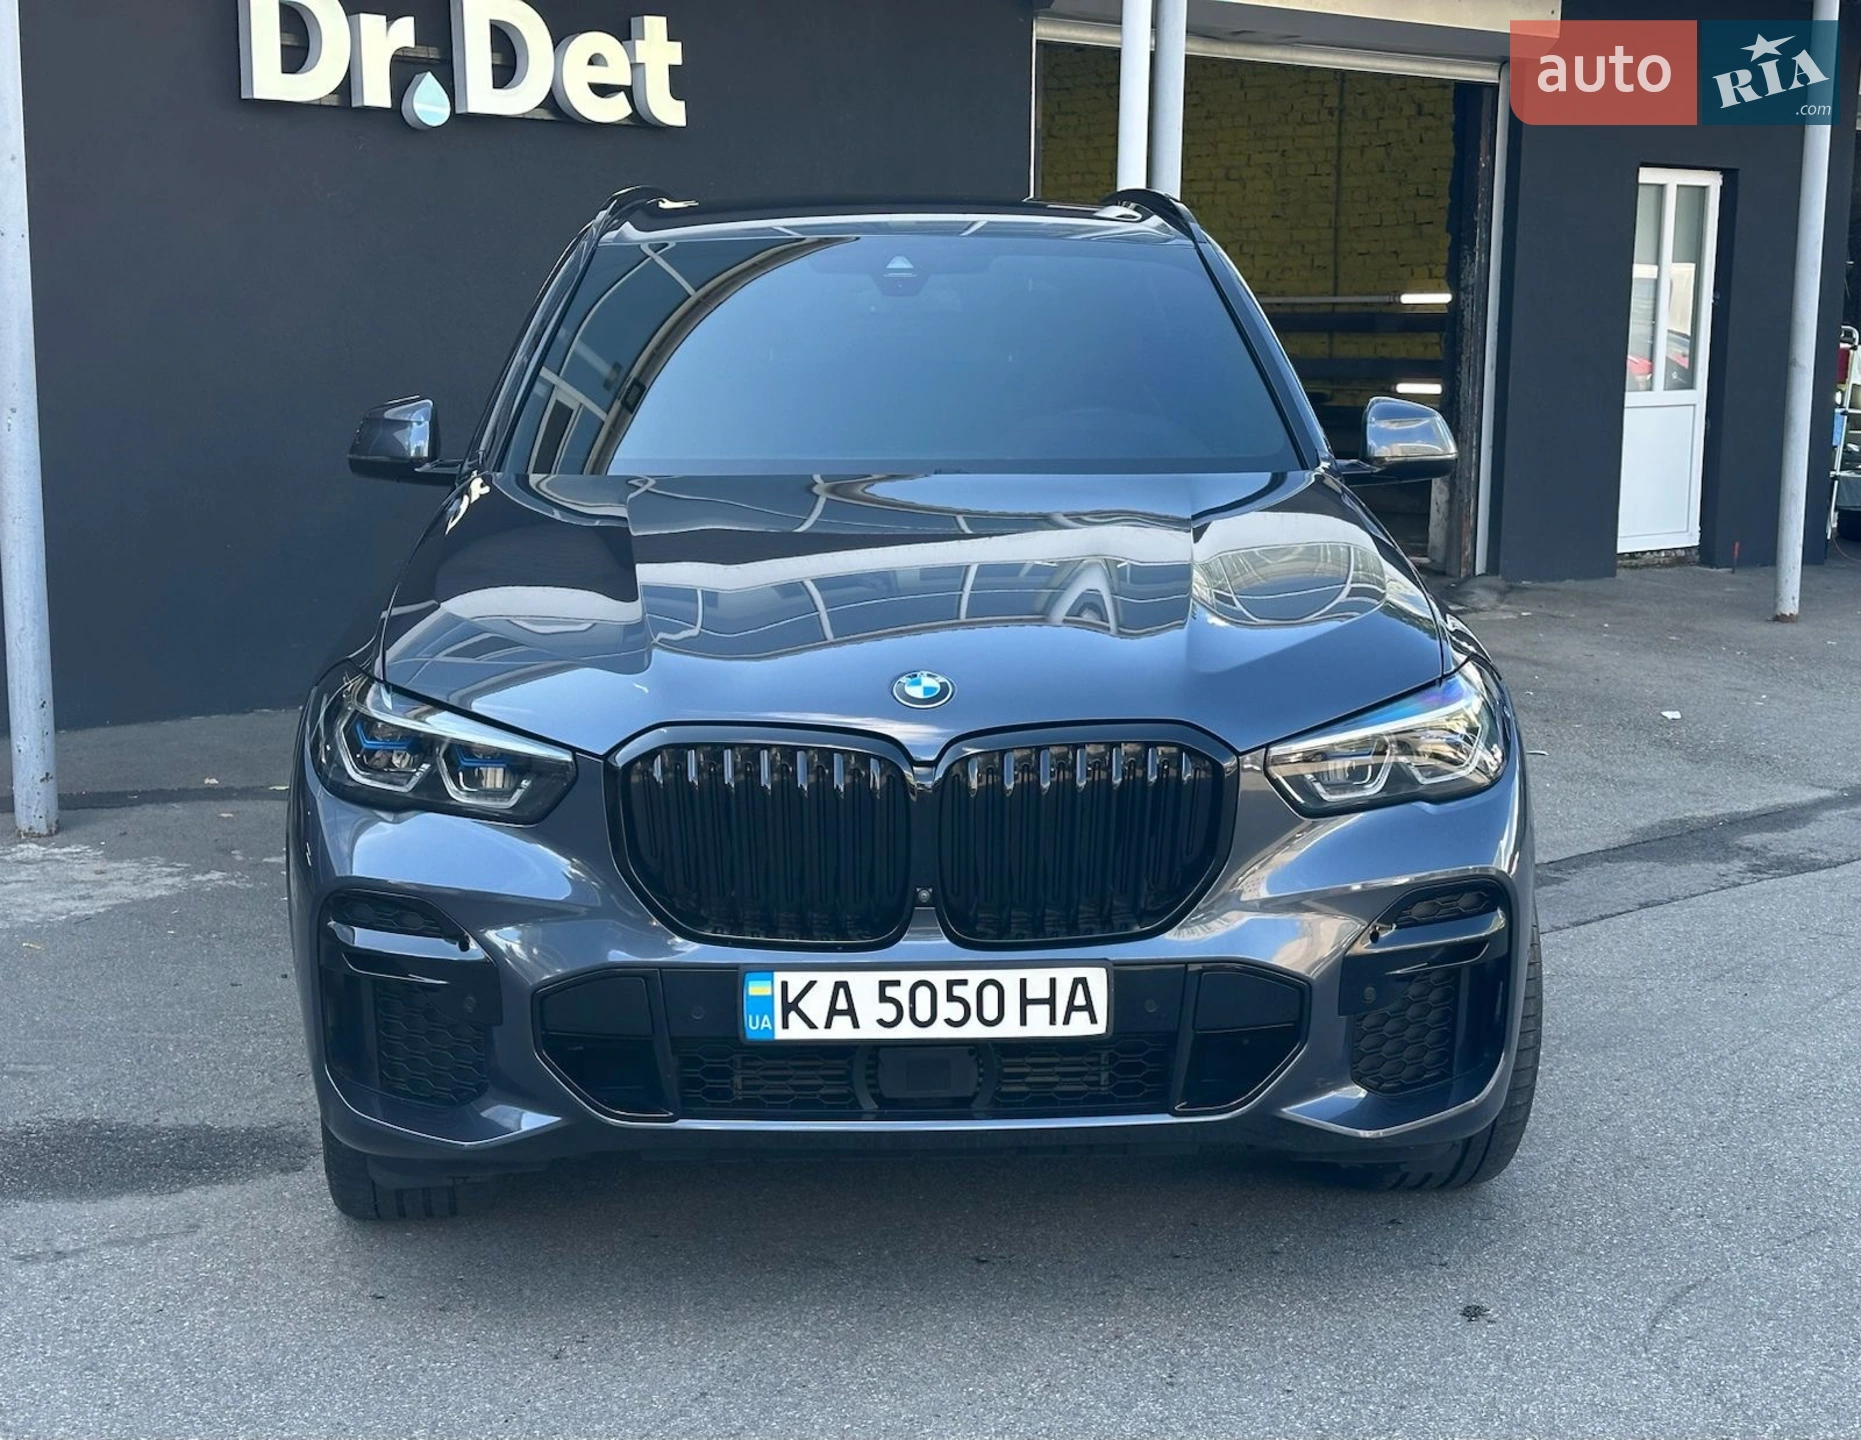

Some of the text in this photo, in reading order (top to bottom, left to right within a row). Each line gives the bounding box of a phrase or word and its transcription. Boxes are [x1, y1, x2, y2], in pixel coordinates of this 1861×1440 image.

[780, 976, 1098, 1030] KA 5050 HA
[748, 1014, 773, 1031] UA
